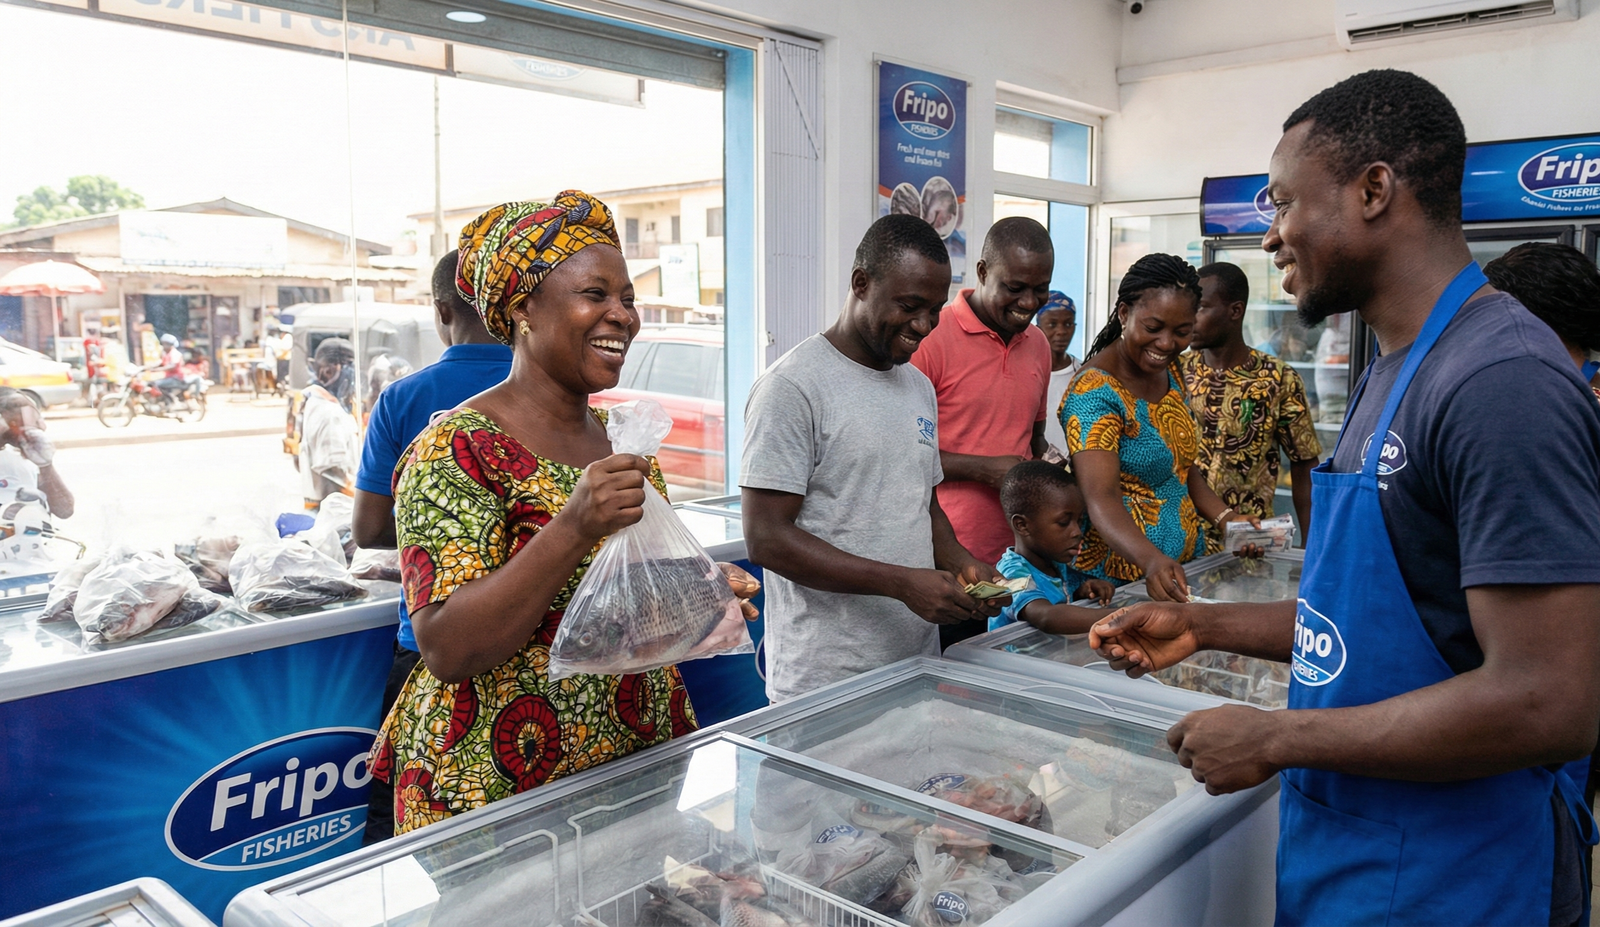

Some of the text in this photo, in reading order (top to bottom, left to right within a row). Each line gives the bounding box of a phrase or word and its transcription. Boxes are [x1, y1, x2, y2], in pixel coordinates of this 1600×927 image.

[902, 89, 948, 123] Fripo
[1535, 153, 1600, 185] Frip
[1552, 187, 1600, 199] FISHERIE
[1294, 614, 1333, 659] ripo
[210, 752, 374, 832] Fripo
[241, 814, 352, 864] FISHERIES
[936, 894, 965, 911] Fripo
